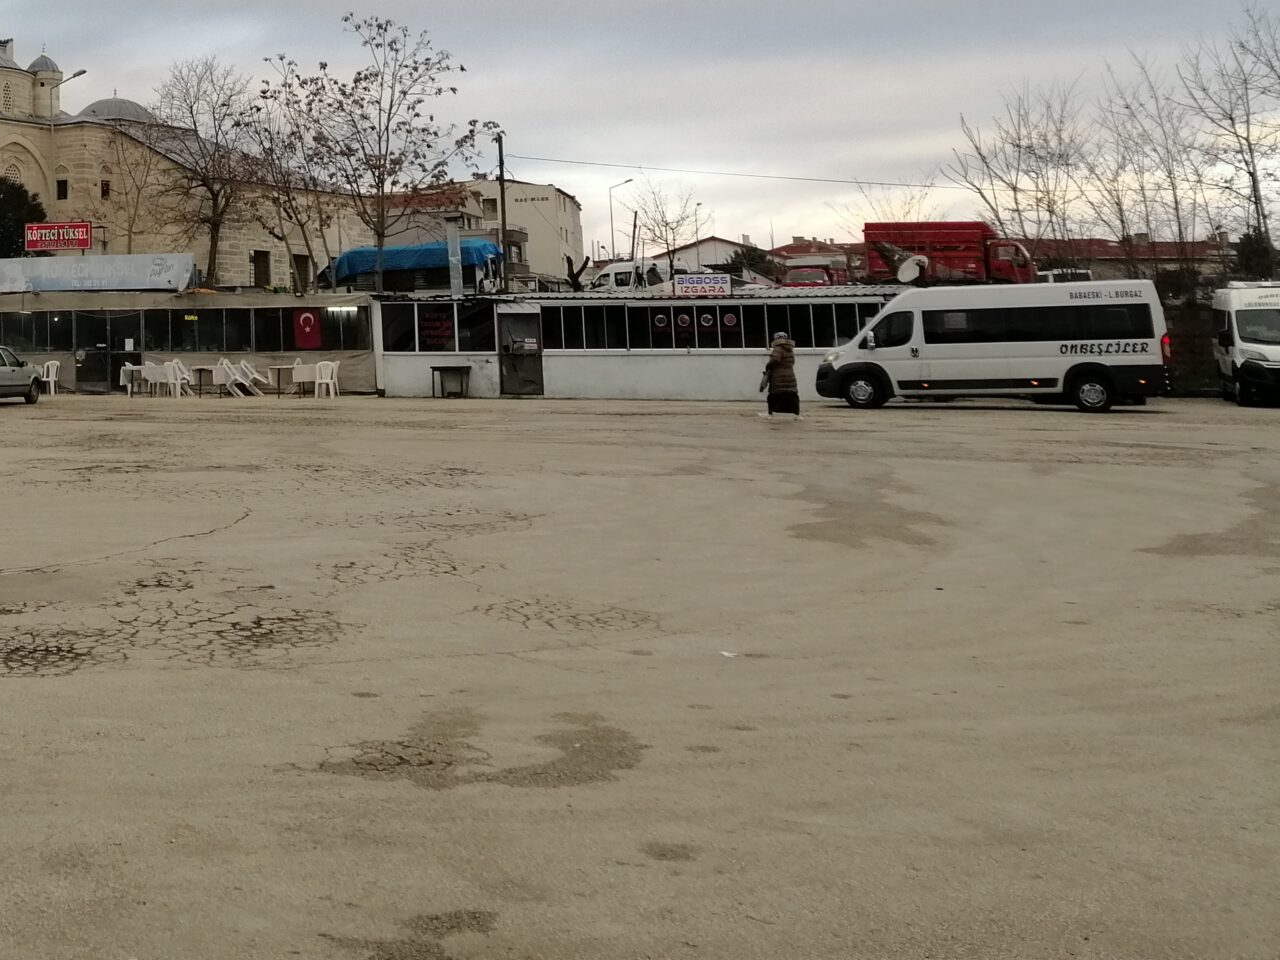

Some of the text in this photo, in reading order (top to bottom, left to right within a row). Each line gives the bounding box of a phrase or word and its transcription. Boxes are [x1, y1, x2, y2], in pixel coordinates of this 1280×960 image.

[27, 226, 88, 241] KÖFTECİ YÜKSEL
[1069, 290, 1103, 300] BABAESKİ
[1060, 341, 1149, 357] ONBEŞLİLER
